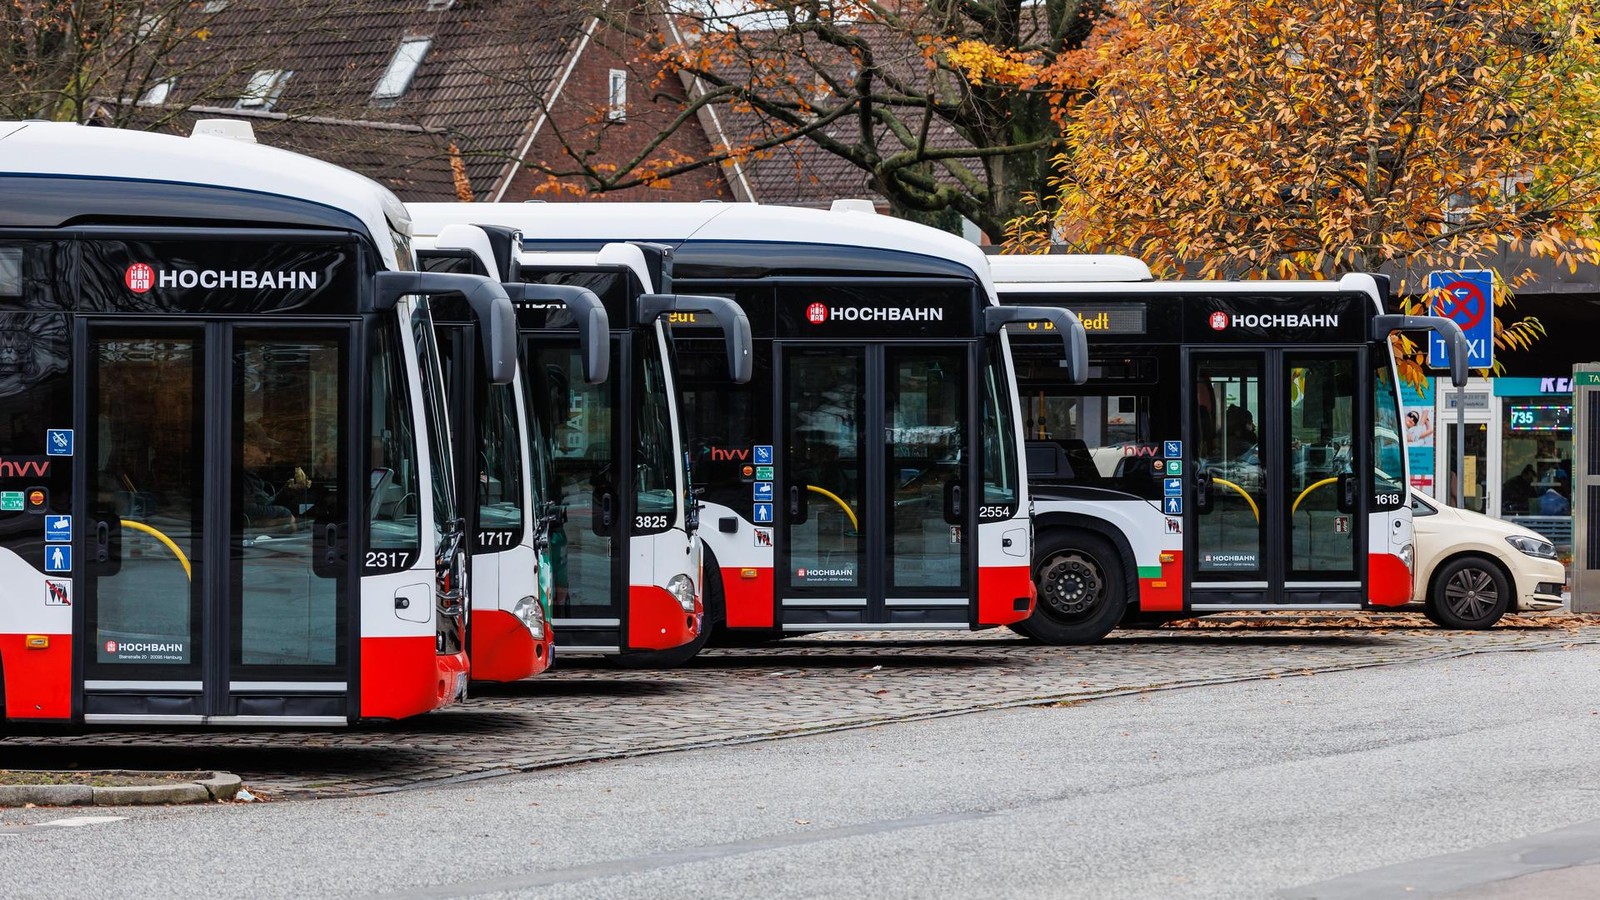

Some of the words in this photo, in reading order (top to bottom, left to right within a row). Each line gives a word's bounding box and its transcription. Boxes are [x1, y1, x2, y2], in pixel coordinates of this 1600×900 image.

[159, 269, 317, 290] HOCHBAHN
[830, 307, 943, 321] HOCHBAHN
[1232, 314, 1339, 328] HOCHBAHN
[1436, 339, 1486, 359] TXI
[1512, 411, 1534, 424] 735
[711, 446, 749, 461] hvv
[1123, 444, 1159, 457] hvv
[0, 457, 50, 477] hvv
[1374, 493, 1400, 505] 1618
[979, 506, 1010, 518] 2554
[635, 515, 668, 529] 3825
[477, 532, 513, 546] 1717
[365, 551, 410, 568] 2317
[118, 643, 183, 652] HOCHBAHN
